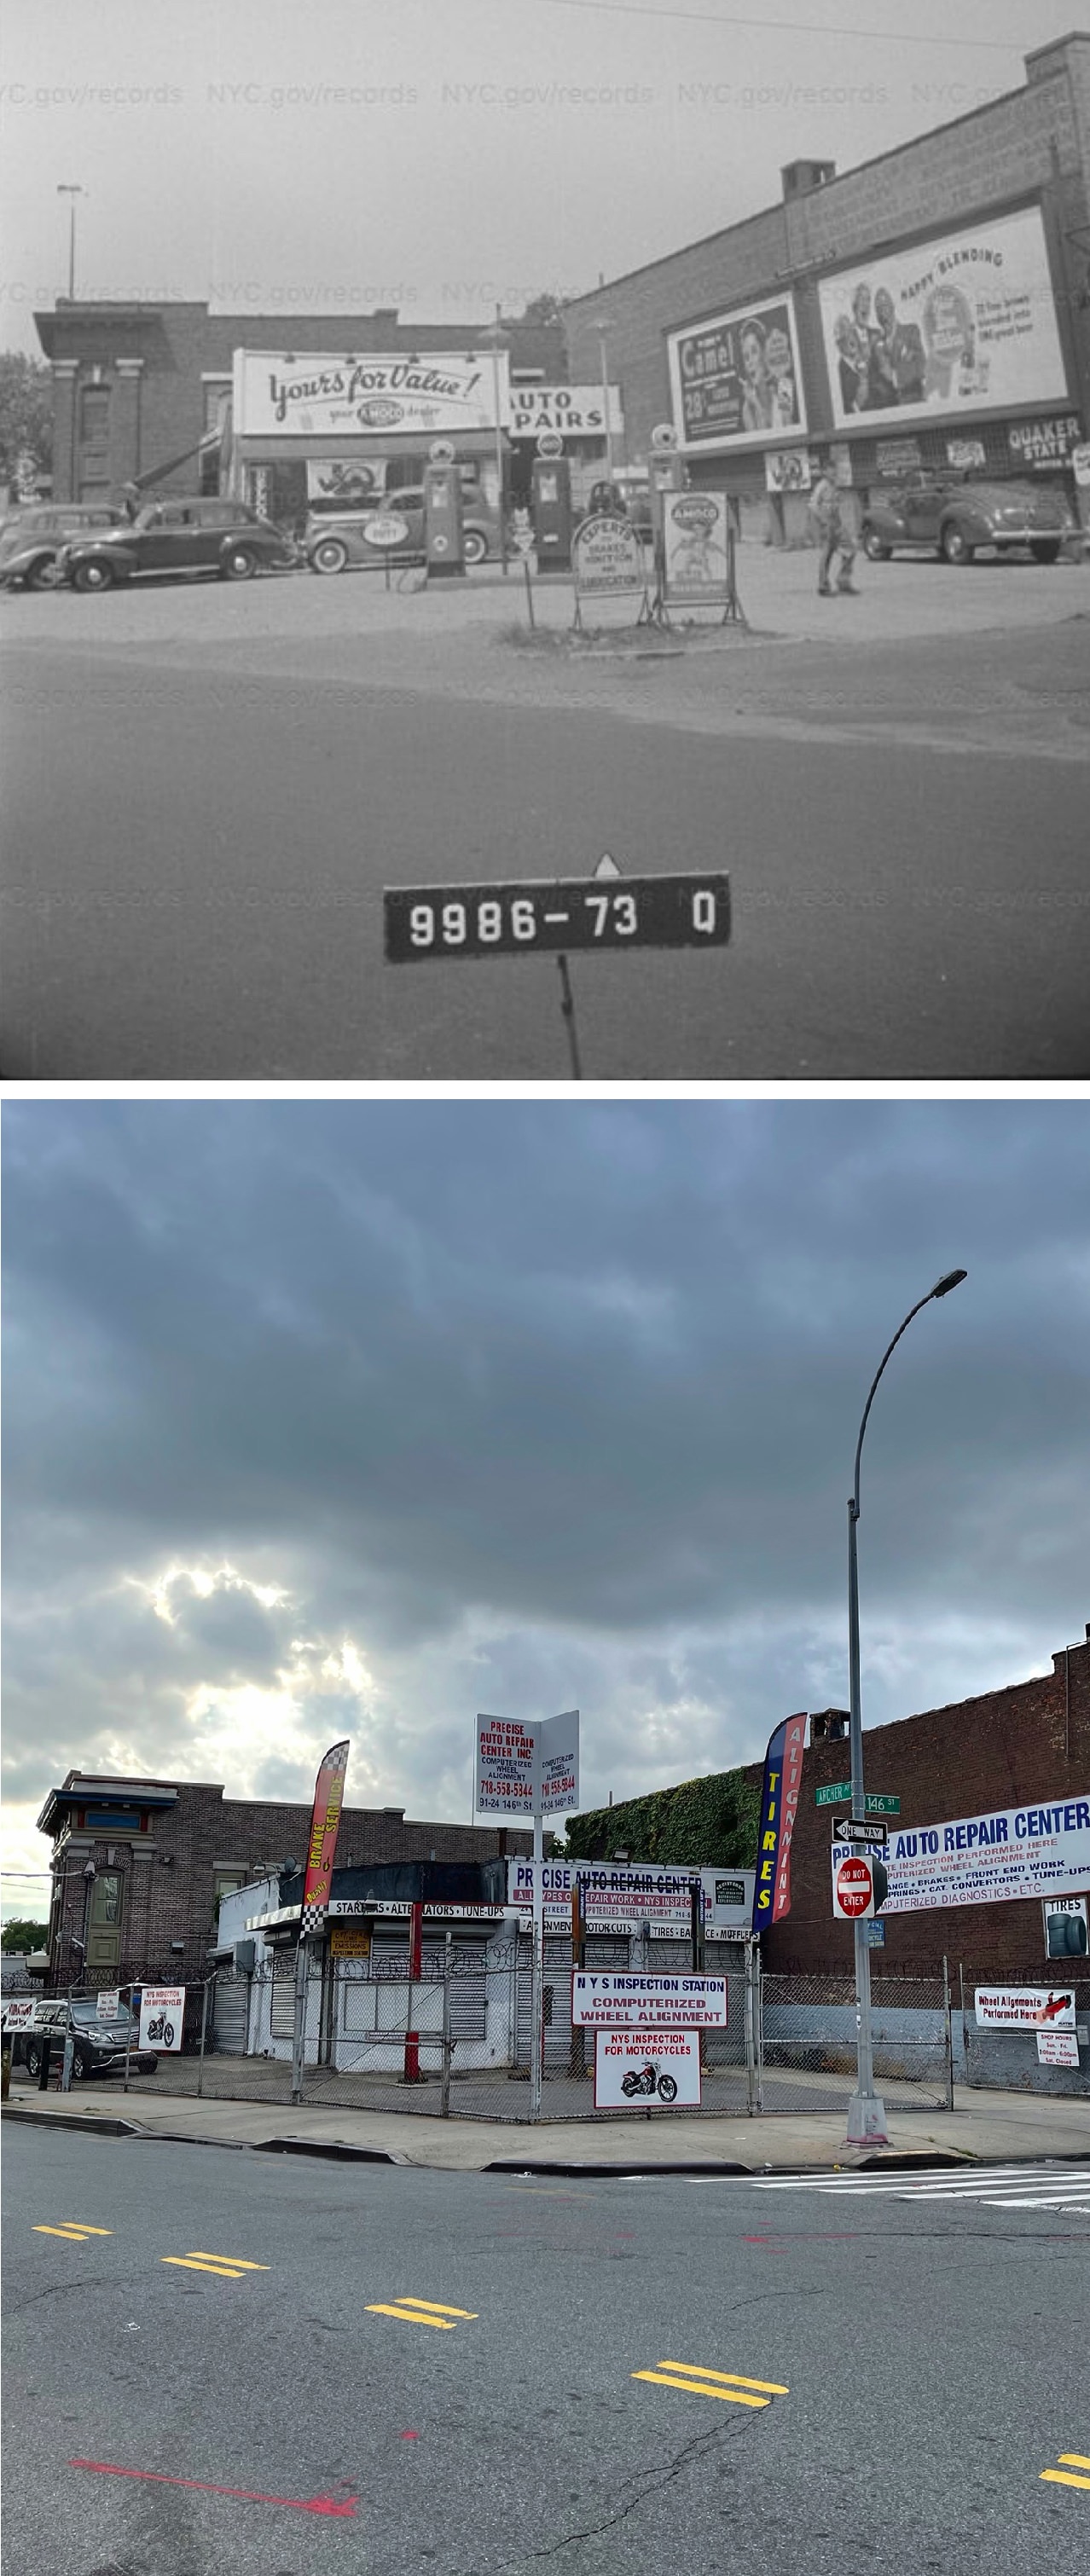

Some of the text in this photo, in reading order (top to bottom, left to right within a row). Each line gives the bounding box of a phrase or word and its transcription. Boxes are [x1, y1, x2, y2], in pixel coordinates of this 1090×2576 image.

[938, 247, 1003, 275] BLENDING
[348, 364, 387, 402] for
[515, 412, 603, 430] PAIRS
[1009, 415, 1081, 450] QUAKER
[1023, 437, 1067, 460] STATE
[692, 890, 716, 935] Q
[490, 1721, 525, 1735] PRECISE
[479, 1732, 535, 1749] AUTO REPAIR
[480, 1745, 533, 1760] CENTER INC.
[481, 1757, 532, 1768] COMPUTERIZED
[542, 1753, 574, 1768] COMPUTERIZED
[496, 1765, 519, 1774] WHEEL
[546, 1768, 571, 1781] ALIGNMENT
[549, 1763, 565, 1774] WHEEL
[488, 1773, 526, 1782] ALIGNMENT
[480, 1780, 533, 1798] 718-558-5844
[541, 1774, 576, 1798] 718558-5844
[819, 1786, 843, 1803] ARCHER
[325, 1774, 343, 1834] SERVICE
[479, 1797, 535, 1811] 91-24 146th St.
[867, 1797, 885, 1810] 146
[832, 1801, 1090, 1870] PRISE AUTO REPAIR CENTER
[841, 1826, 881, 1838] ONE WAY
[309, 1822, 326, 1870] BRAKE
[757, 1772, 780, 1909] TIRES
[899, 1855, 954, 1870] INSPECTION
[957, 1843, 1023, 1861] PERFORMED
[1028, 1838, 1058, 1850] HERE
[887, 1867, 936, 1880] PUTERIZED
[940, 1861, 975, 1873] WHEEL
[977, 1850, 1041, 1867] ALIGNMENT
[517, 1867, 703, 1896] PRCISE AUTO REPAIR CENTER
[842, 1869, 866, 1880] DO NOT
[887, 1859, 1065, 1890] ANGE BRAKES FRONT END WORK
[887, 1888, 920, 1898] PRINGS
[951, 1874, 1021, 1890] CONVERTORS
[1032, 1865, 1090, 1880] TUNE-UPS
[518, 1890, 534, 1901] ALL
[542, 1892, 563, 1902] YPES
[585, 1894, 609, 1903] EPAIR
[611, 1895, 635, 1904] WORK
[644, 1897, 660, 1906] NYS
[662, 1897, 708, 1908] INSPEC
[844, 1896, 864, 1907] ENTER
[880, 1882, 1046, 1911] MPUTERIZED DIAGNOSTICS ETC.
[391, 1903, 455, 1915] ALTEATORS
[461, 1906, 505, 1918] TUNE-UPS
[586, 1906, 619, 1916] PUTERIZED
[621, 1907, 640, 1917] WHEEL
[641, 1908, 672, 1918] ALIGNMENT
[1050, 1898, 1081, 1913] TIRES
[611, 1923, 632, 1934] CUTS
[653, 1926, 674, 1937] TIRES
[680, 1927, 715, 1938] BACE
[613, 1977, 679, 1991] INSPECTION
[681, 1979, 725, 1993] STATION
[592, 1997, 706, 2009] COMPUTERIZED
[978, 1995, 1042, 2008] Wheel Alignments
[580, 2011, 722, 2022] WHEEL ALIGNMENT
[983, 2008, 1037, 2020] Performed Here
[611, 2034, 685, 2044] NYS INSPECTION
[605, 2045, 692, 2055] FOR MOTORCYCLES
